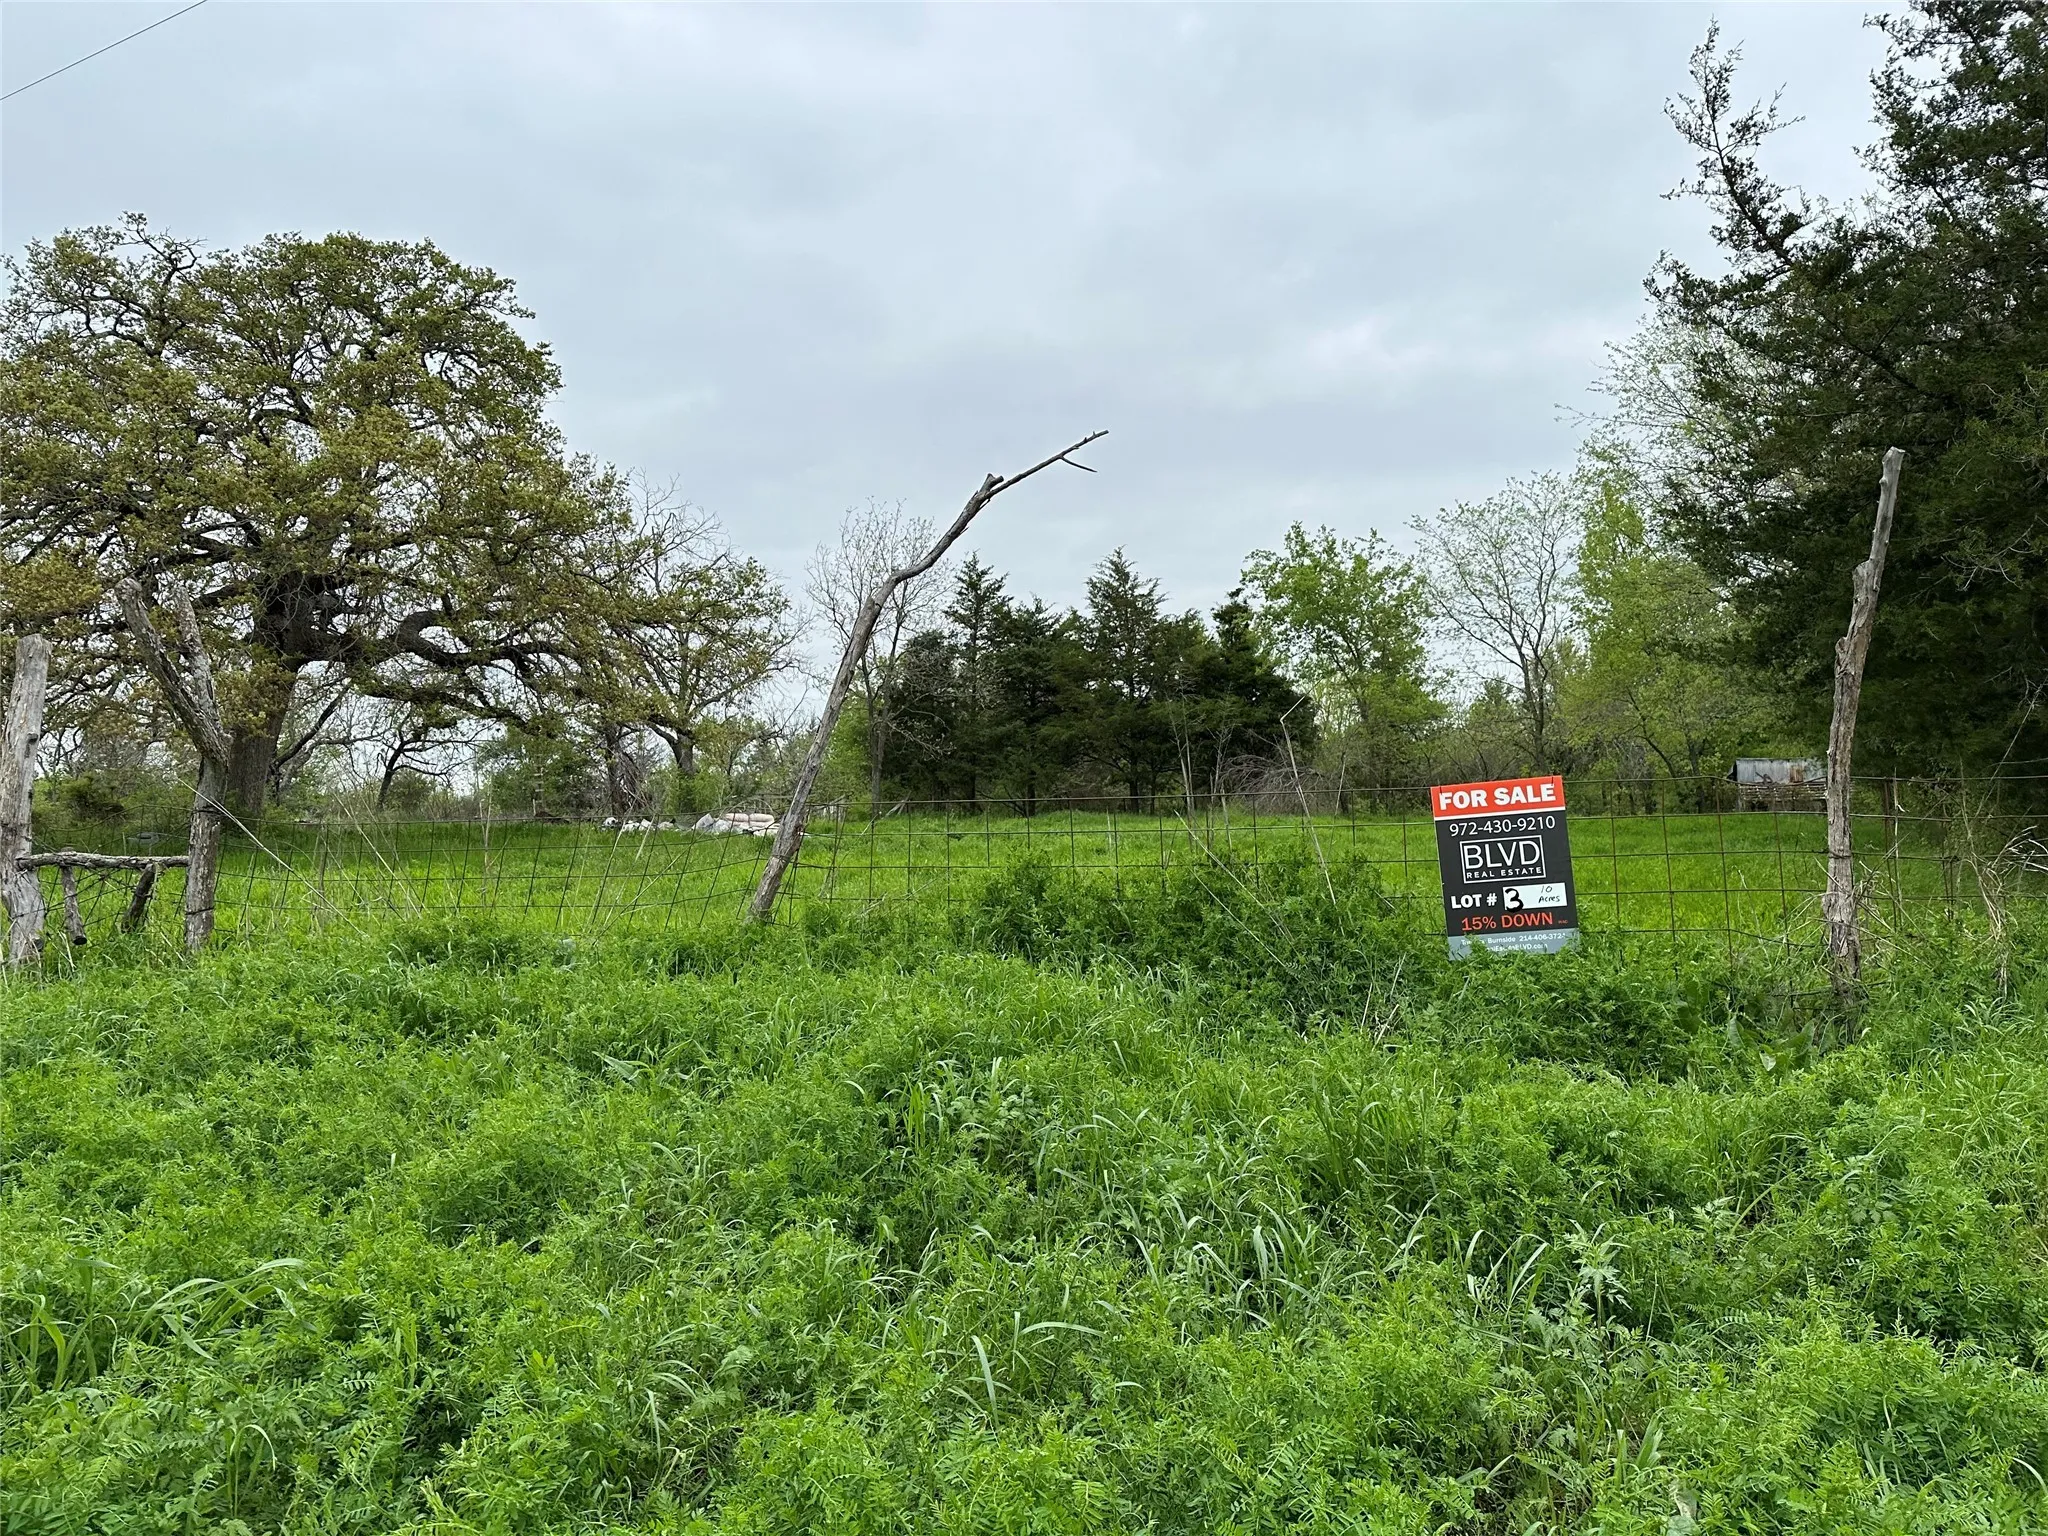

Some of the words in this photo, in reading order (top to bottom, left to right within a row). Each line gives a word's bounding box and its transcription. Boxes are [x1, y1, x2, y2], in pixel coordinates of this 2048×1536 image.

[1439, 789, 1488, 810] FOR
[1494, 783, 1556, 806] SALE
[1449, 815, 1556, 836] 972-430-9210
[1463, 840, 1541, 869] BLVD
[1466, 870, 1495, 879] REAL
[1501, 867, 1542, 876] ESTATE
[1541, 885, 1553, 893] 10
[1450, 893, 1482, 909] LOT
[1486, 893, 1497, 906] #
[1504, 888, 1524, 912] 3
[1538, 895, 1560, 903] Acres
[1461, 916, 1497, 931] 15%
[1501, 912, 1553, 928] DOWN
[1487, 936, 1516, 944] Burnside
